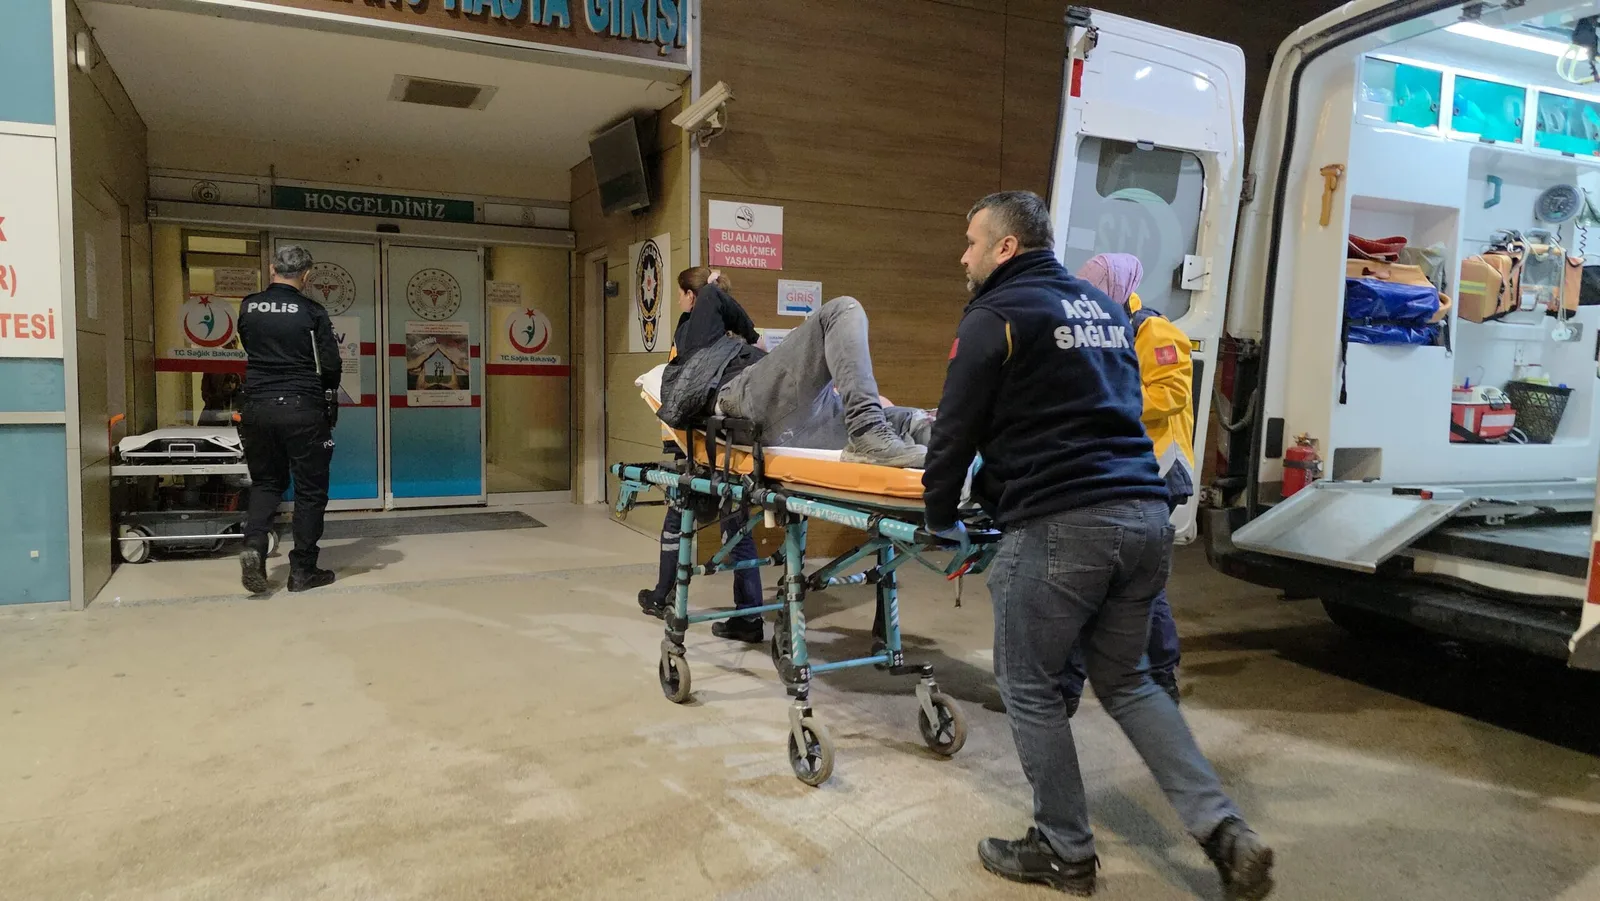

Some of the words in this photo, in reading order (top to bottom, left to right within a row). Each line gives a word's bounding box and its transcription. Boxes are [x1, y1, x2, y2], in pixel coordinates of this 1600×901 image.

[721, 231, 734, 241] BU
[735, 232, 771, 244] ALANDA
[714, 241, 748, 254] SİGARA
[749, 244, 777, 257] İÇMEK
[725, 255, 767, 268] YASAKTIR
[786, 289, 814, 304] GİRİŞ
[1053, 320, 1130, 350] SAĞLIK
